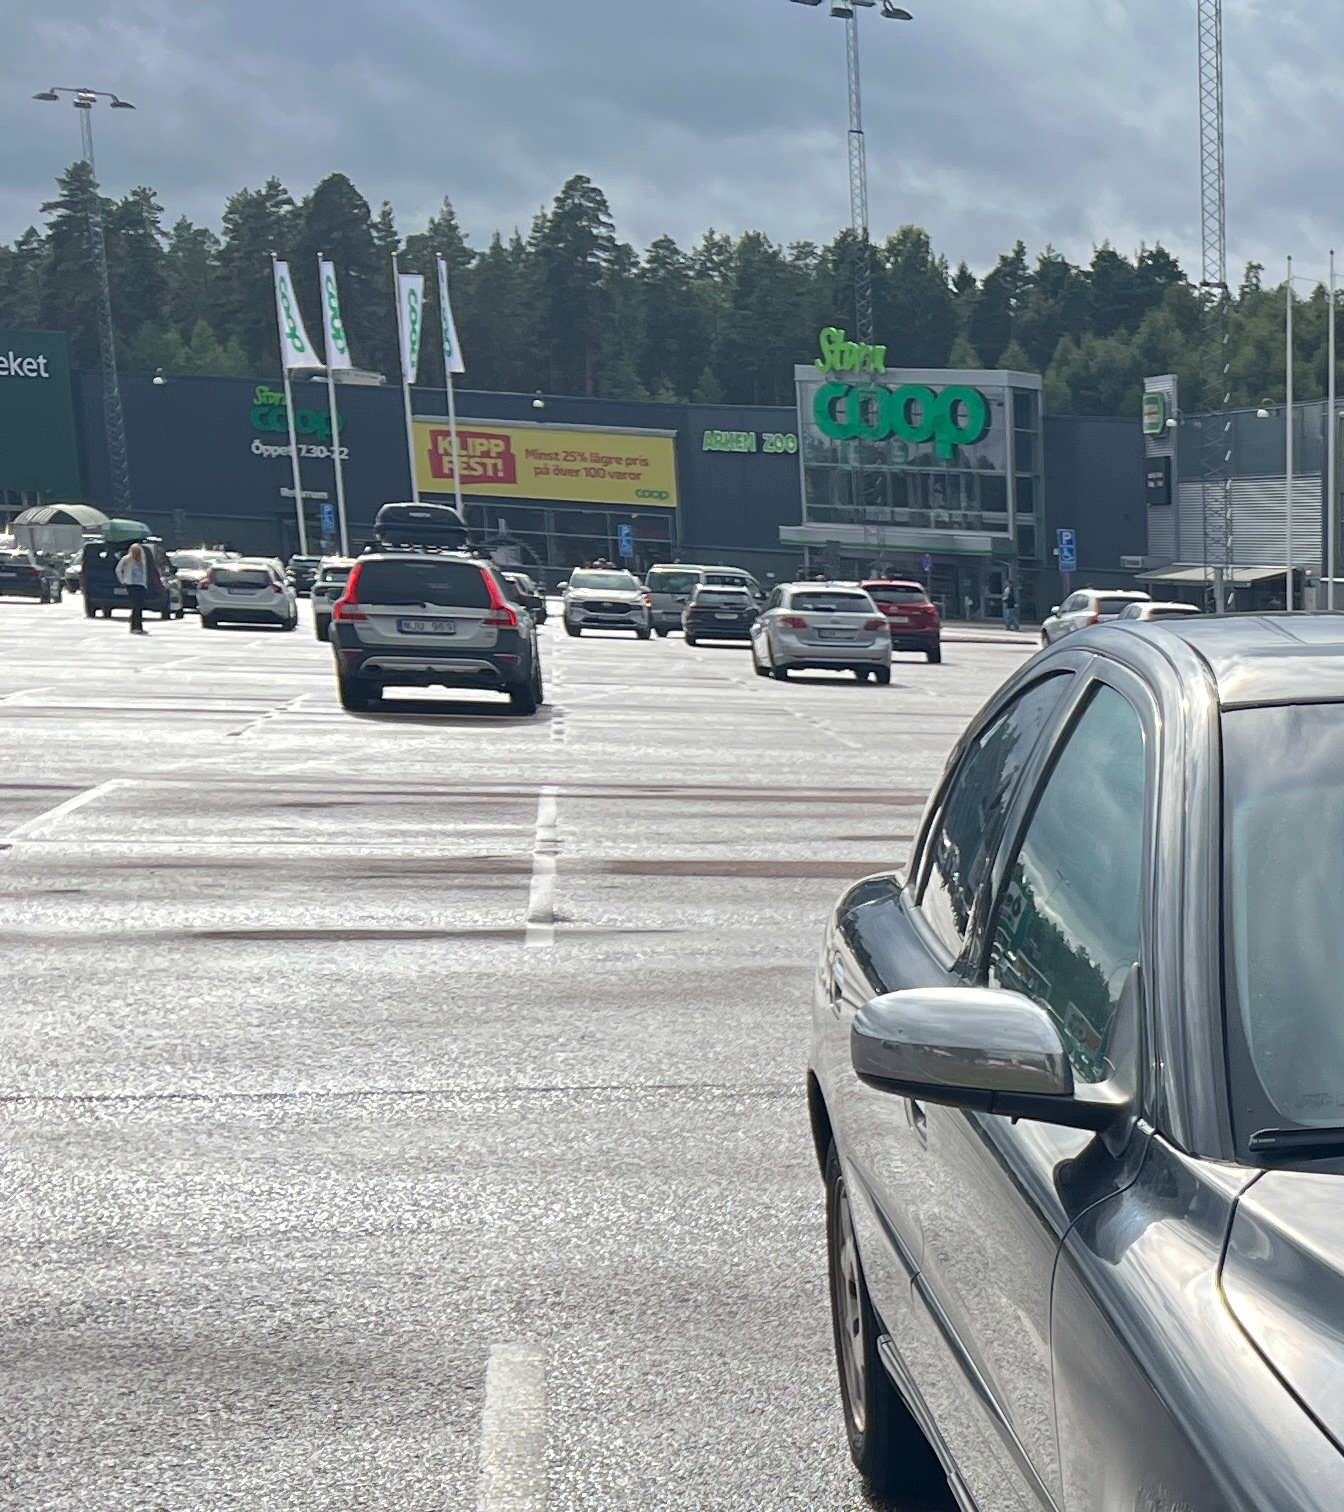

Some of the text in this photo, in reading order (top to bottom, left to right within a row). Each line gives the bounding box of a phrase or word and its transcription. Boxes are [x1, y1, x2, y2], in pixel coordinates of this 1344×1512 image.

[813, 381, 988, 459] coop
[437, 435, 505, 456] KLIPP
[702, 430, 798, 453] ARKEN ZOO
[442, 455, 505, 477] FEST!
[524, 448, 649, 467] Minst 25% lägre pris
[553, 464, 581, 477] över
[584, 467, 606, 479] 100
[1062, 531, 1072, 545] P
